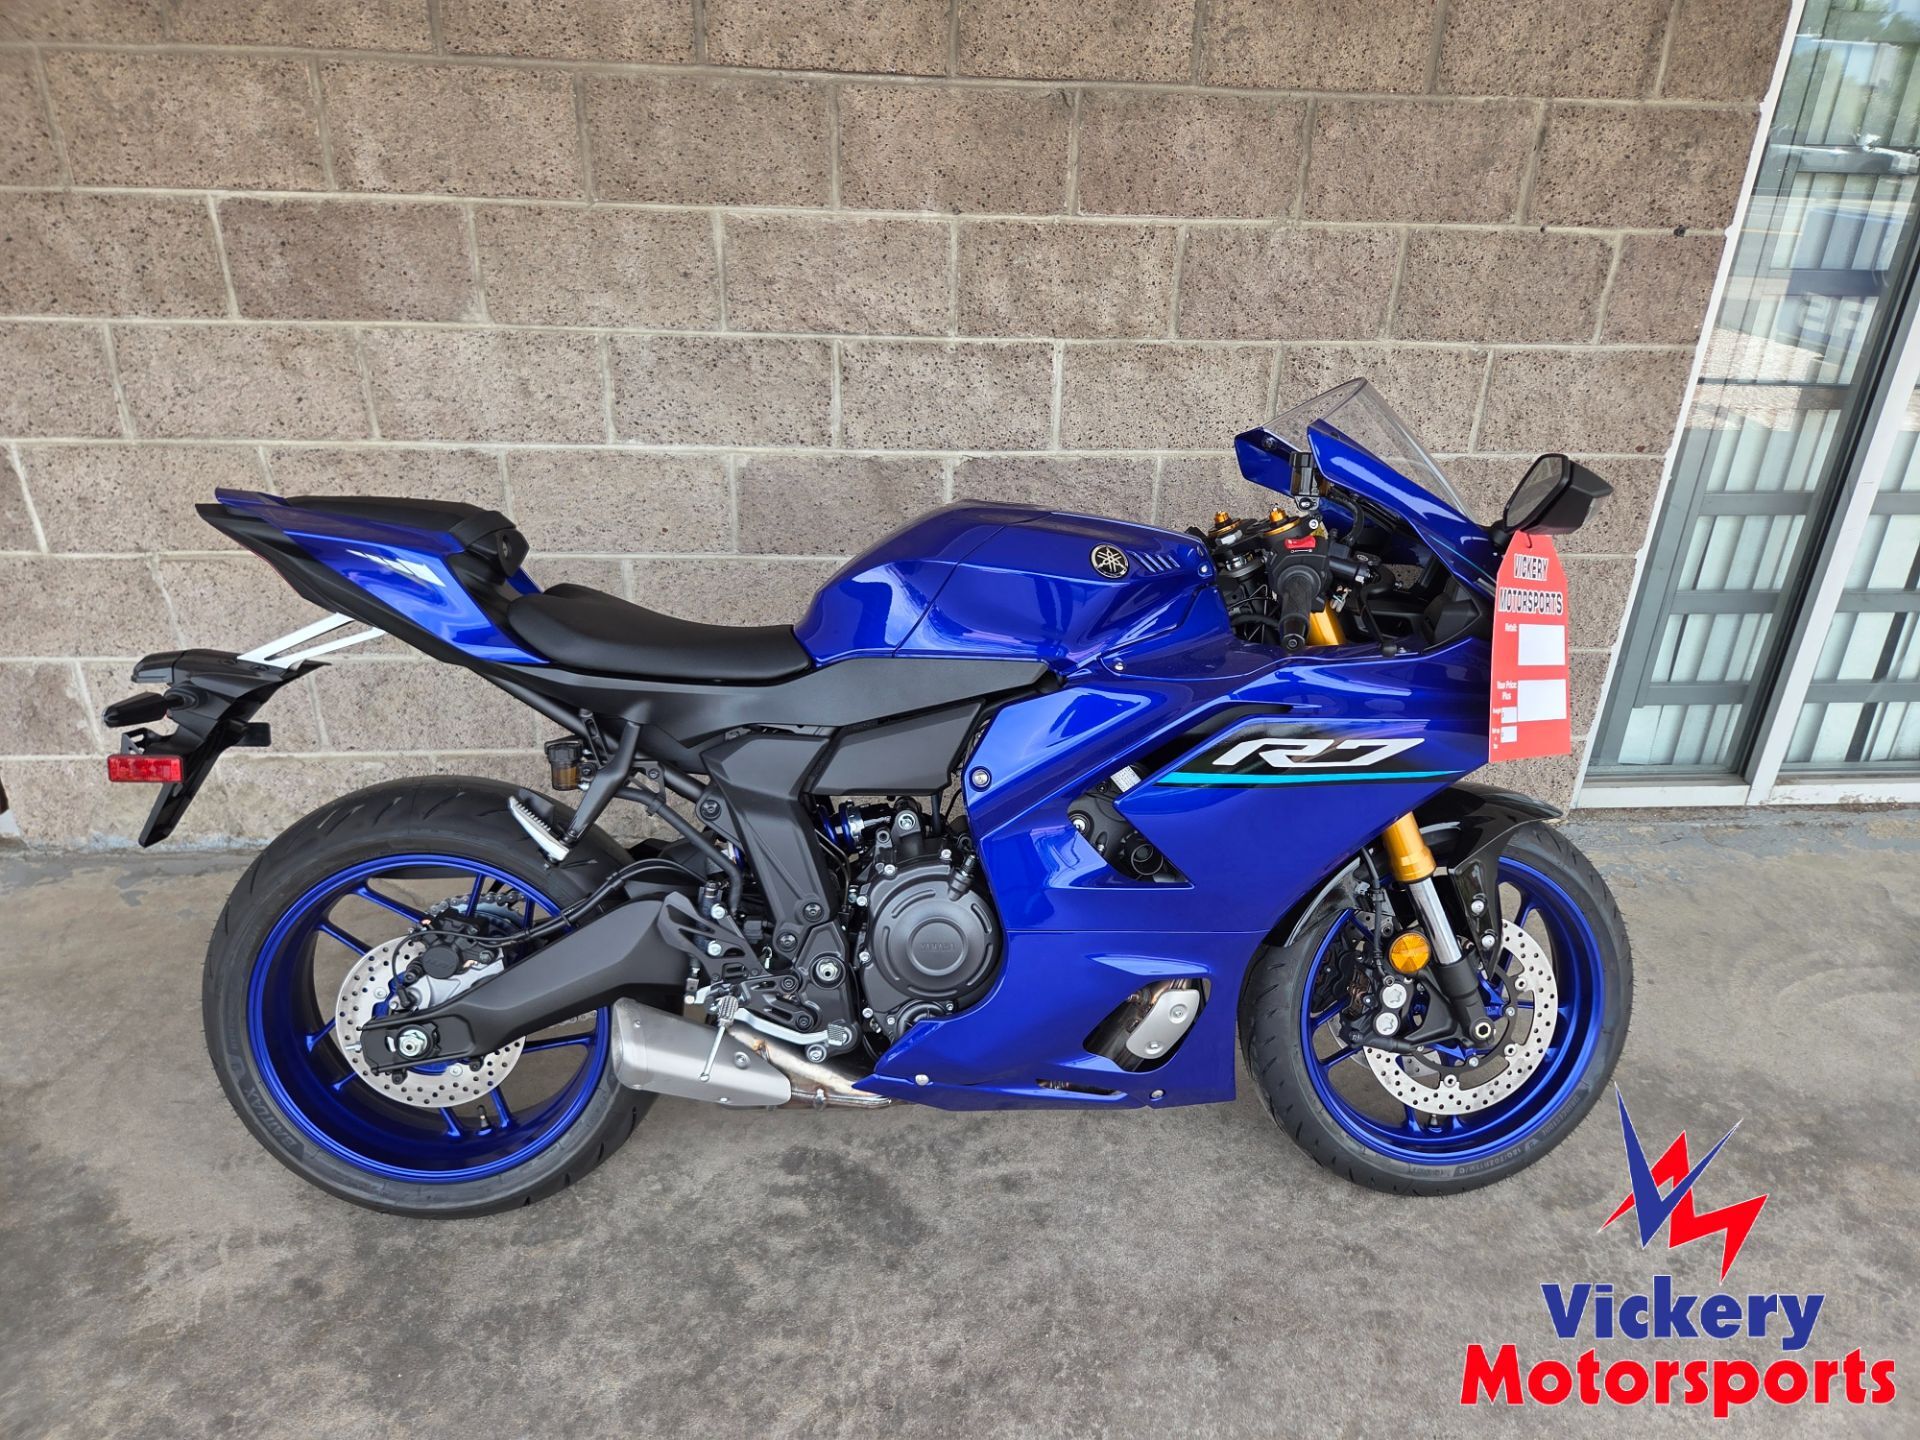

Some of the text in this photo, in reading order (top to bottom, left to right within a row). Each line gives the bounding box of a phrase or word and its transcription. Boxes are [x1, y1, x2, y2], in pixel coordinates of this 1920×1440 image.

[1513, 553, 1549, 582] VICKERY
[1498, 586, 1563, 615] MOTORSPORTS
[1212, 737, 1425, 768] R7
[244, 1087, 300, 1148] BATTLAX
